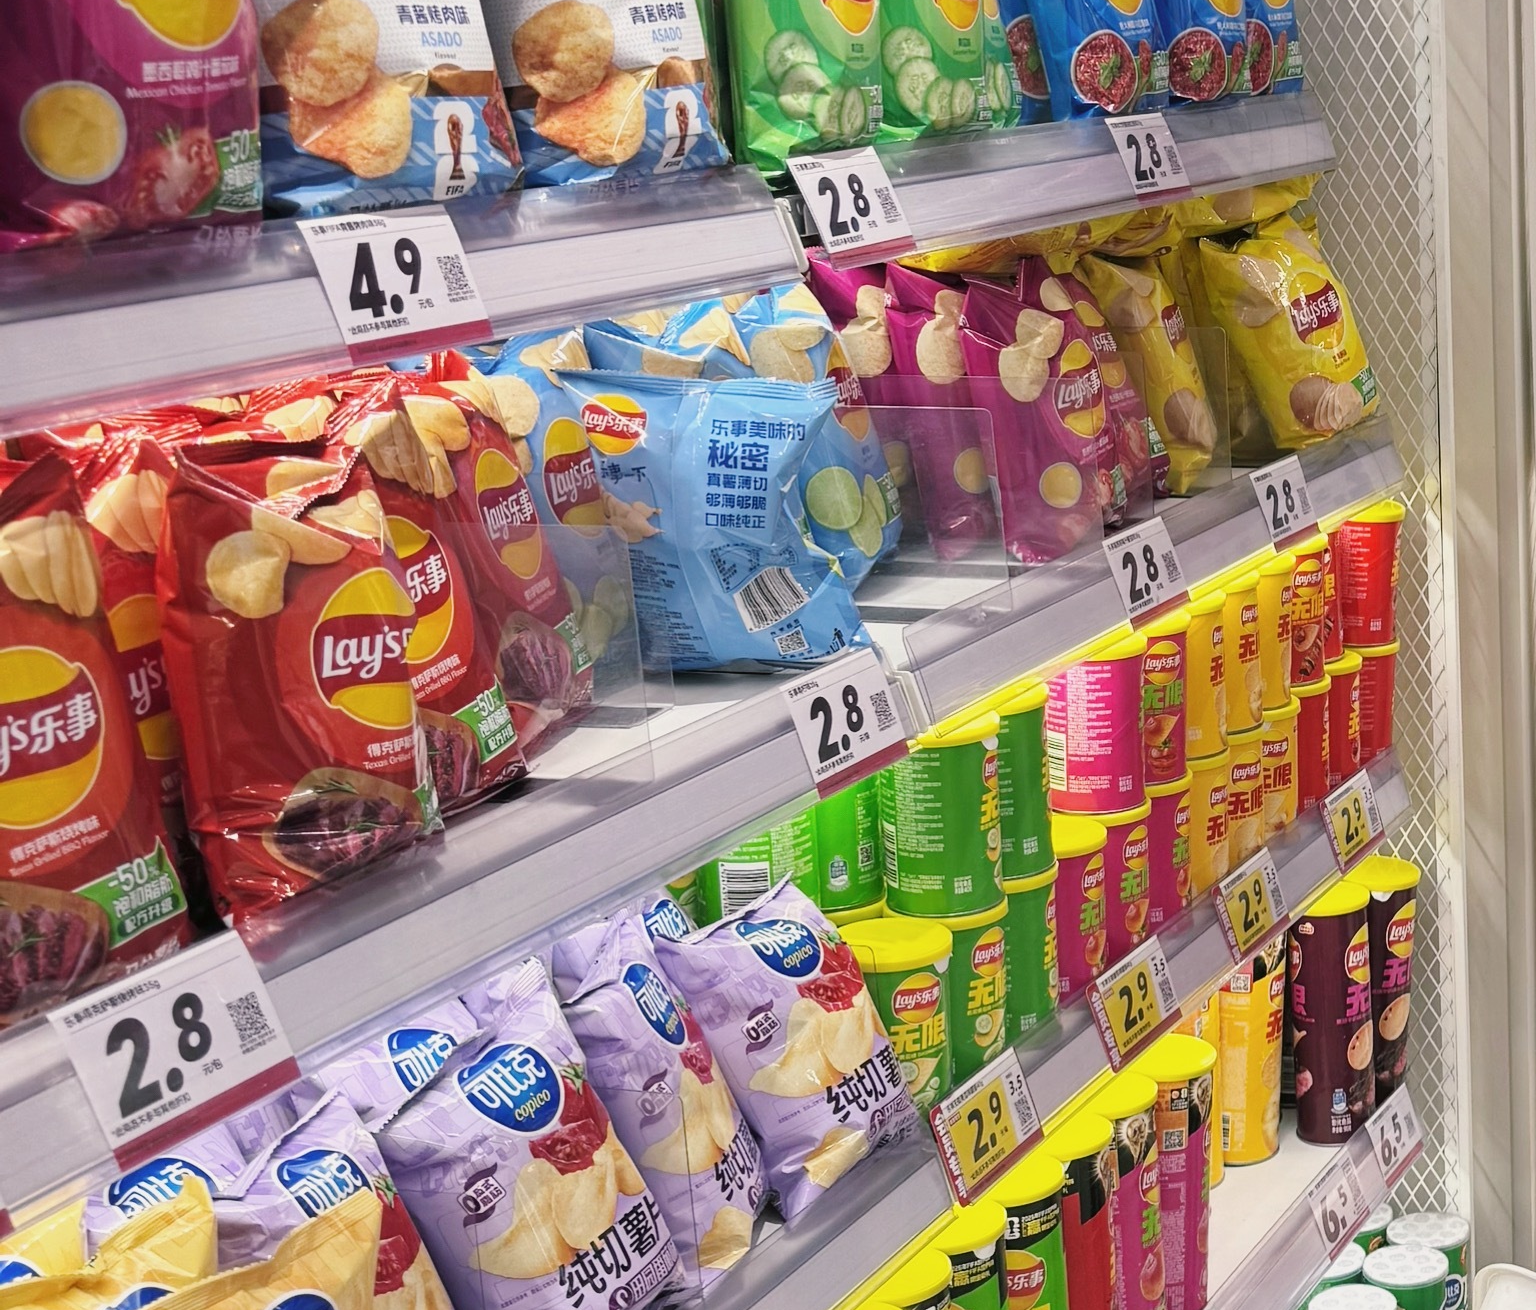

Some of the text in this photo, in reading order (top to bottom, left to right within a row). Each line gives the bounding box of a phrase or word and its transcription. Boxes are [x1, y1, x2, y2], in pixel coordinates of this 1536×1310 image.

[420, 29, 463, 49] ASADO
[650, 25, 684, 44] ASADO
[1126, 133, 1163, 185] 2.8
[817, 174, 866, 236] 2.8
[349, 237, 422, 319] 4.9
[711, 418, 806, 442] 乐事美味的
[707, 441, 770, 472] 秘密
[705, 491, 767, 511] 够薄够脆
[706, 472, 768, 492] 真薯薄切
[1266, 483, 1296, 529] 2.8
[704, 511, 767, 530] 口味纯正
[1122, 543, 1159, 601] 2.8
[810, 684, 864, 763] 2.8
[1241, 883, 1263, 933] 2.9
[1120, 971, 1148, 1029] 2.9
[106, 992, 212, 1118] 2.8
[1008, 1074, 1022, 1096] 3.5
[966, 1091, 1003, 1163] 2.9
[1379, 1110, 1405, 1169] 6.5
